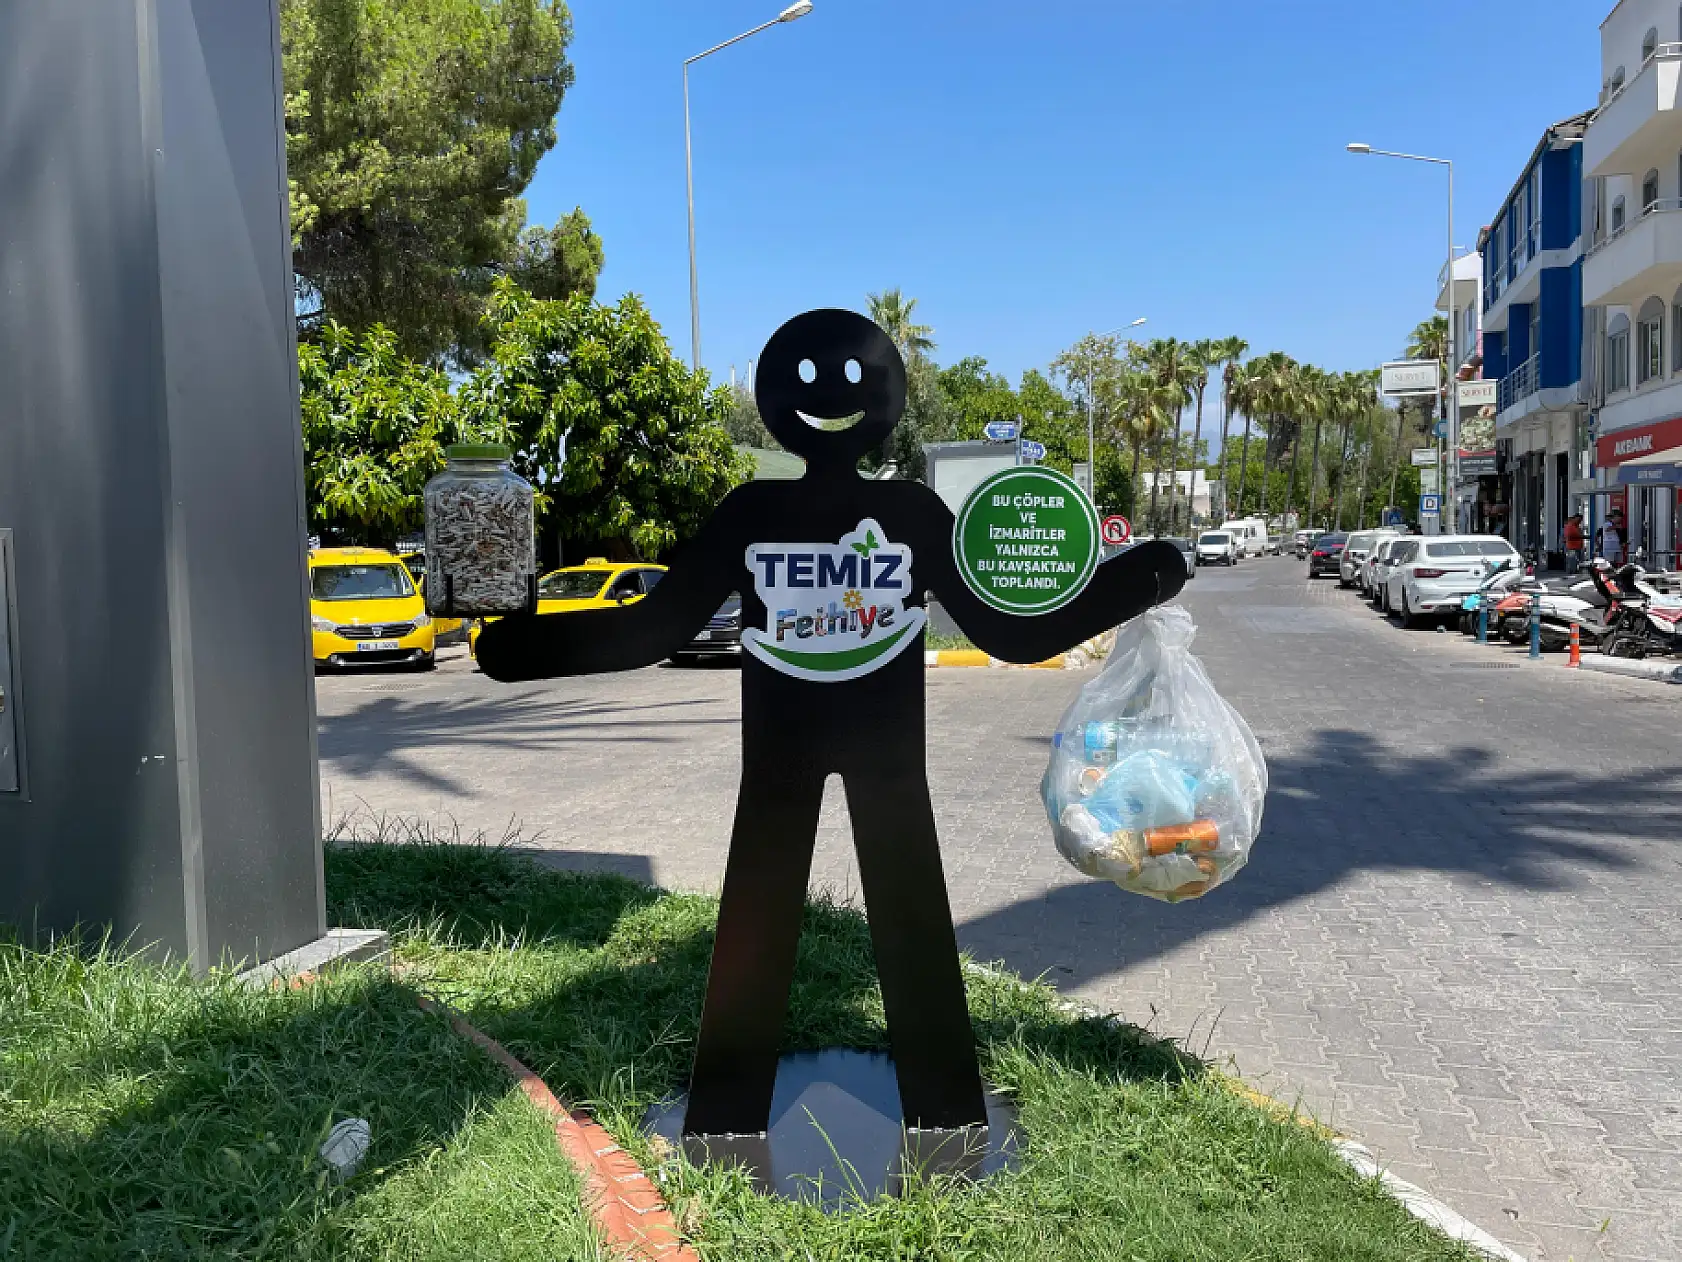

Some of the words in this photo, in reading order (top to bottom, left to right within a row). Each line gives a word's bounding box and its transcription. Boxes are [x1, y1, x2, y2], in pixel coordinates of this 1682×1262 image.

[991, 494, 1010, 507] BU
[1013, 492, 1065, 509] ÇÖPLER
[1020, 511, 1037, 523] VE
[989, 524, 1067, 541] İZMARİTLER
[995, 544, 1059, 557] YALNIZCA
[977, 559, 994, 571] BU
[998, 560, 1076, 575] KAVŞAKTAN
[991, 576, 1061, 590] TOPLANDI.
[776, 601, 895, 642] Fethiye
